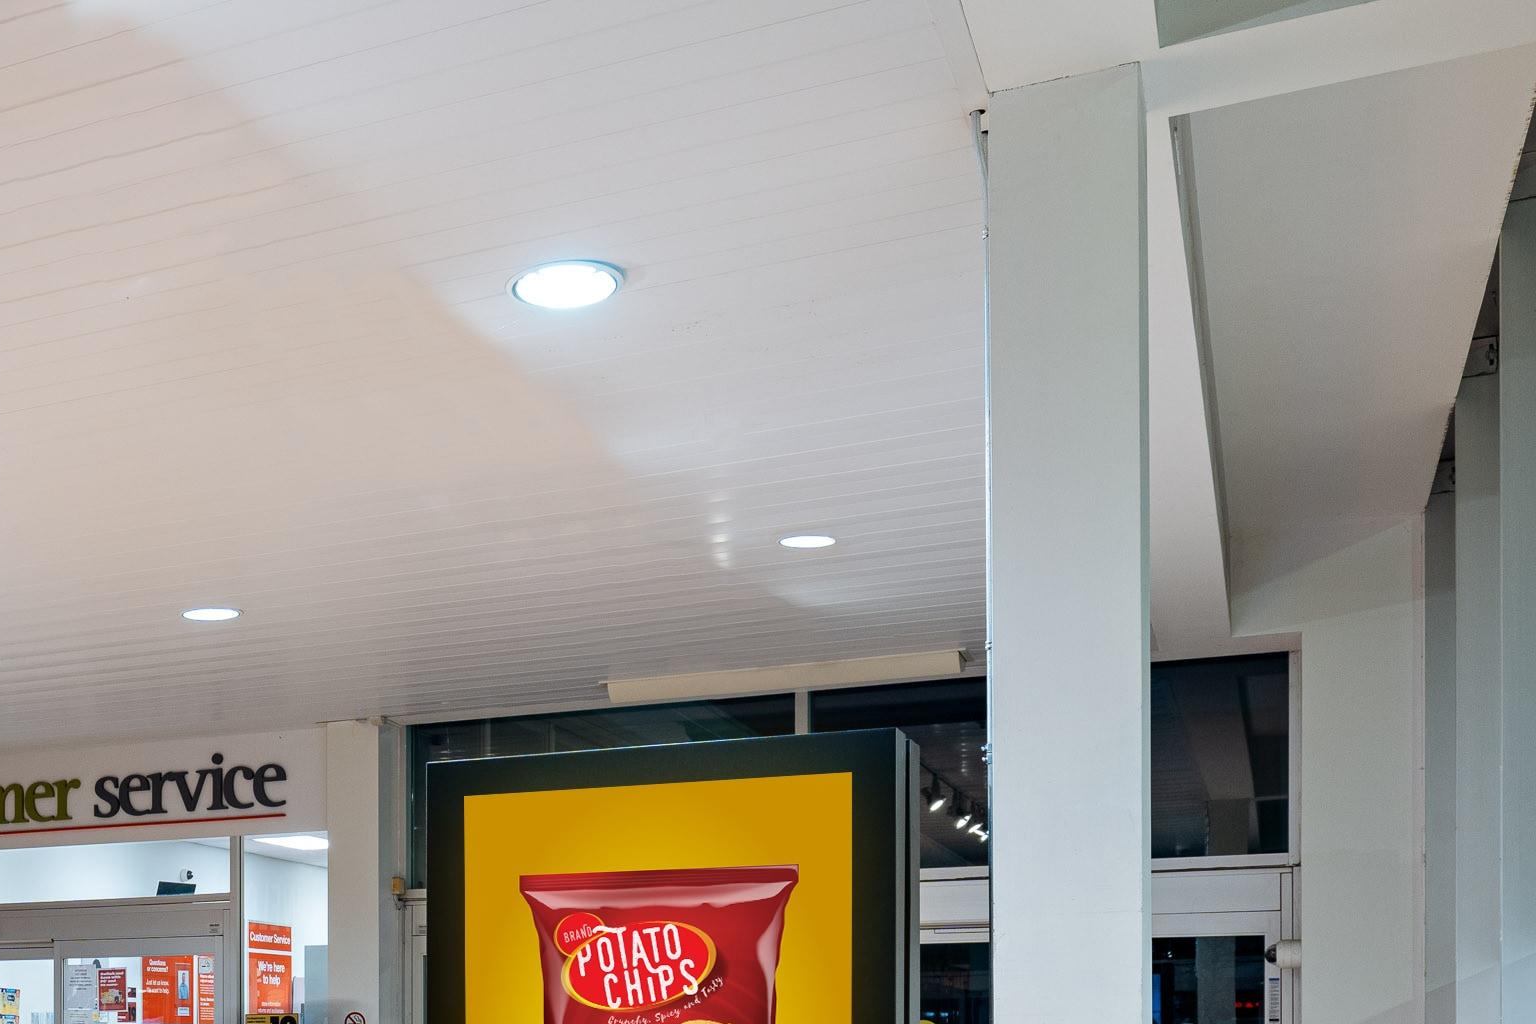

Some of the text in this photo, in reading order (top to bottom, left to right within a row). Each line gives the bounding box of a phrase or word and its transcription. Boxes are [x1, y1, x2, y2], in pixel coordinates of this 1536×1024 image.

[93, 753, 287, 818] service
[249, 931, 291, 945] Customer Service
[564, 924, 593, 943] BRAND
[577, 923, 681, 977] POTATO
[257, 960, 285, 973] We're here
[263, 974, 280, 987] to help
[655, 1008, 681, 1023] Spicy
[683, 994, 701, 1010] and
